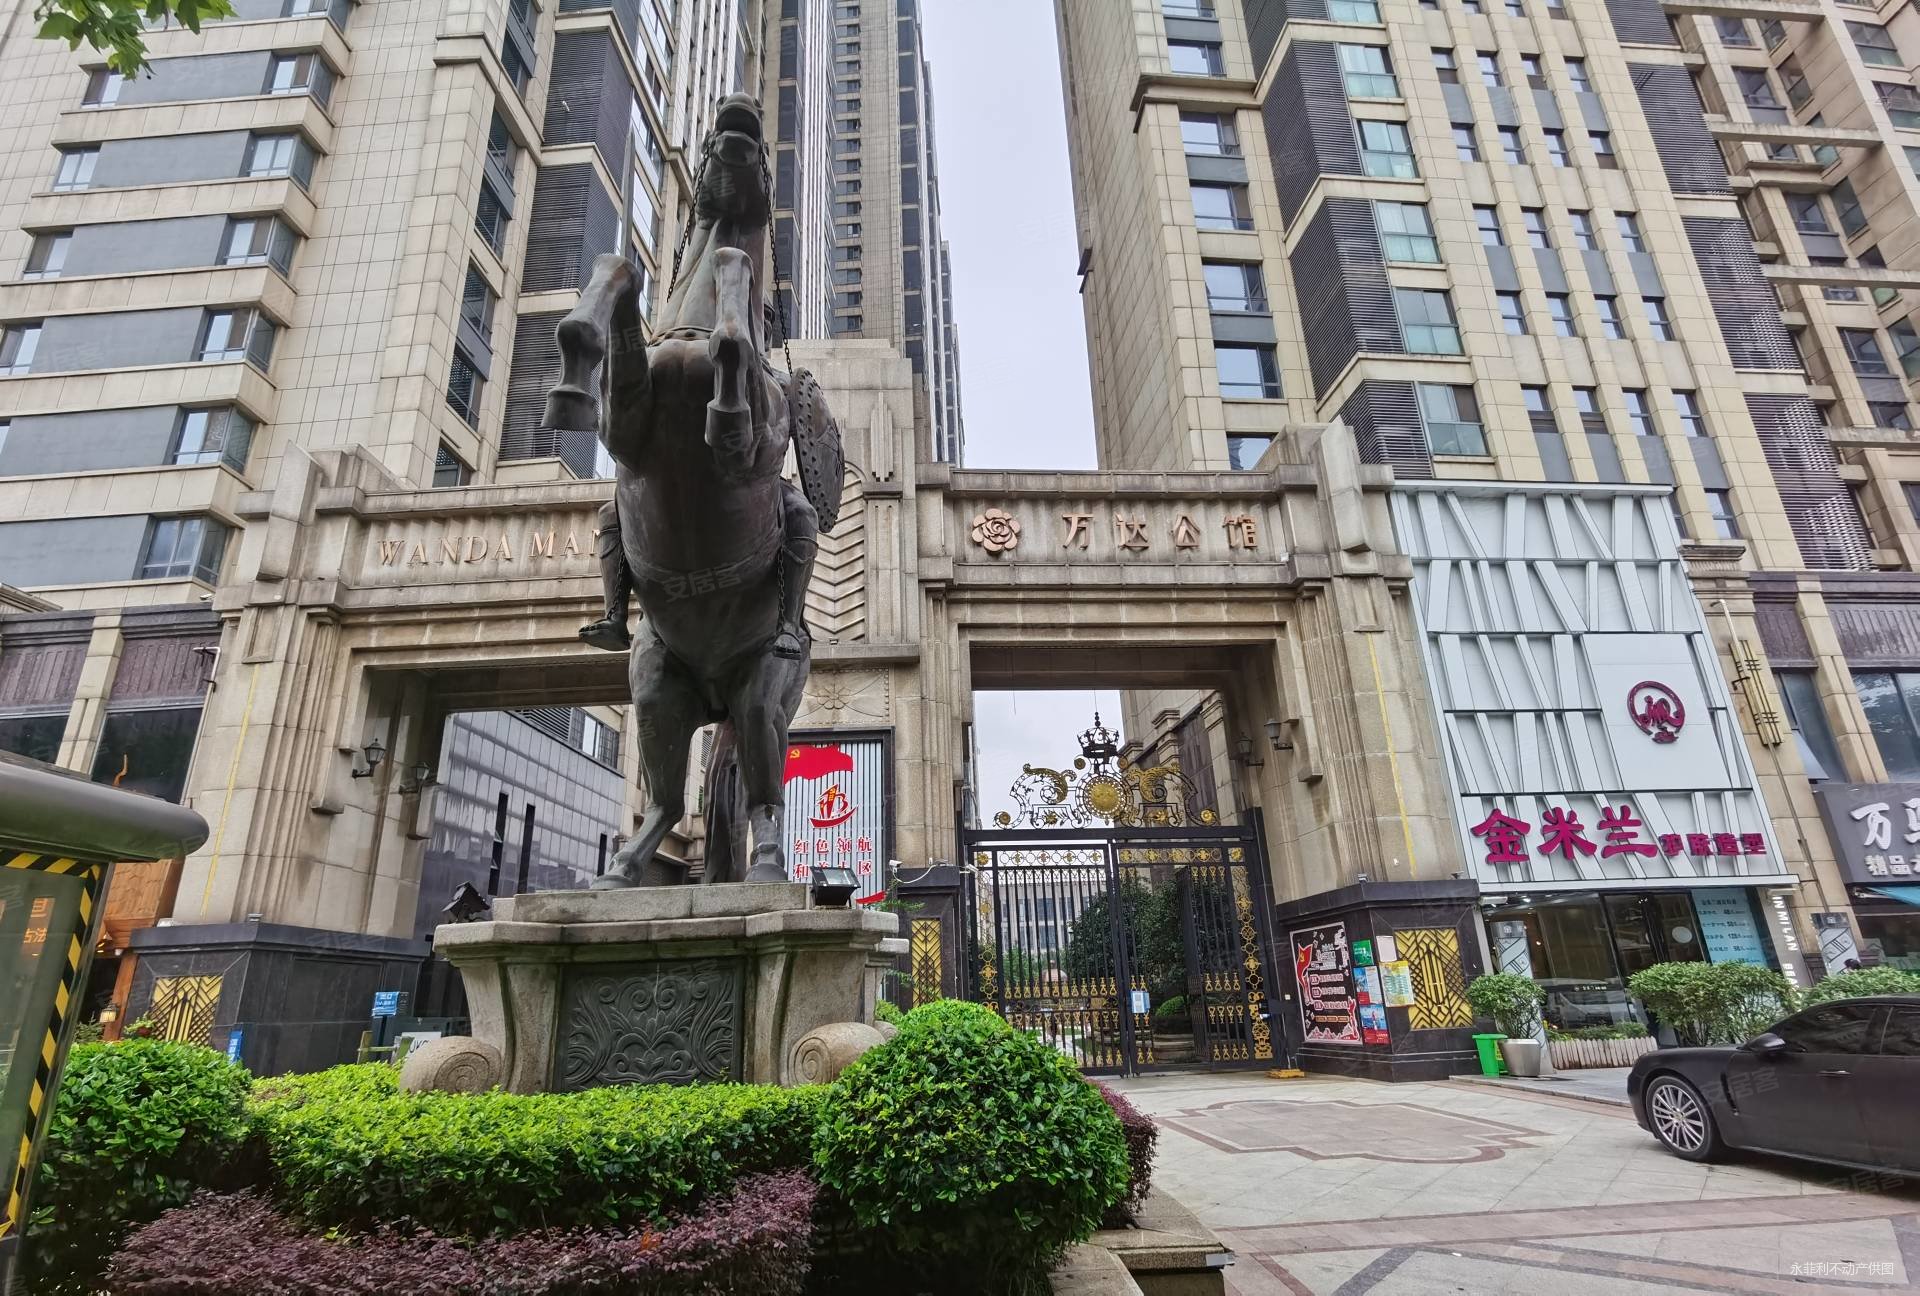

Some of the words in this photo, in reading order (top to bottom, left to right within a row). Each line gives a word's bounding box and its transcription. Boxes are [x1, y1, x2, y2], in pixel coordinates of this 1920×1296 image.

[1062, 512, 1259, 550] 万达公馆
[378, 532, 514, 567] WANDA
[793, 836, 873, 855] 红色领航
[1470, 804, 1659, 865] 金米兰
[793, 859, 873, 879] 和区
